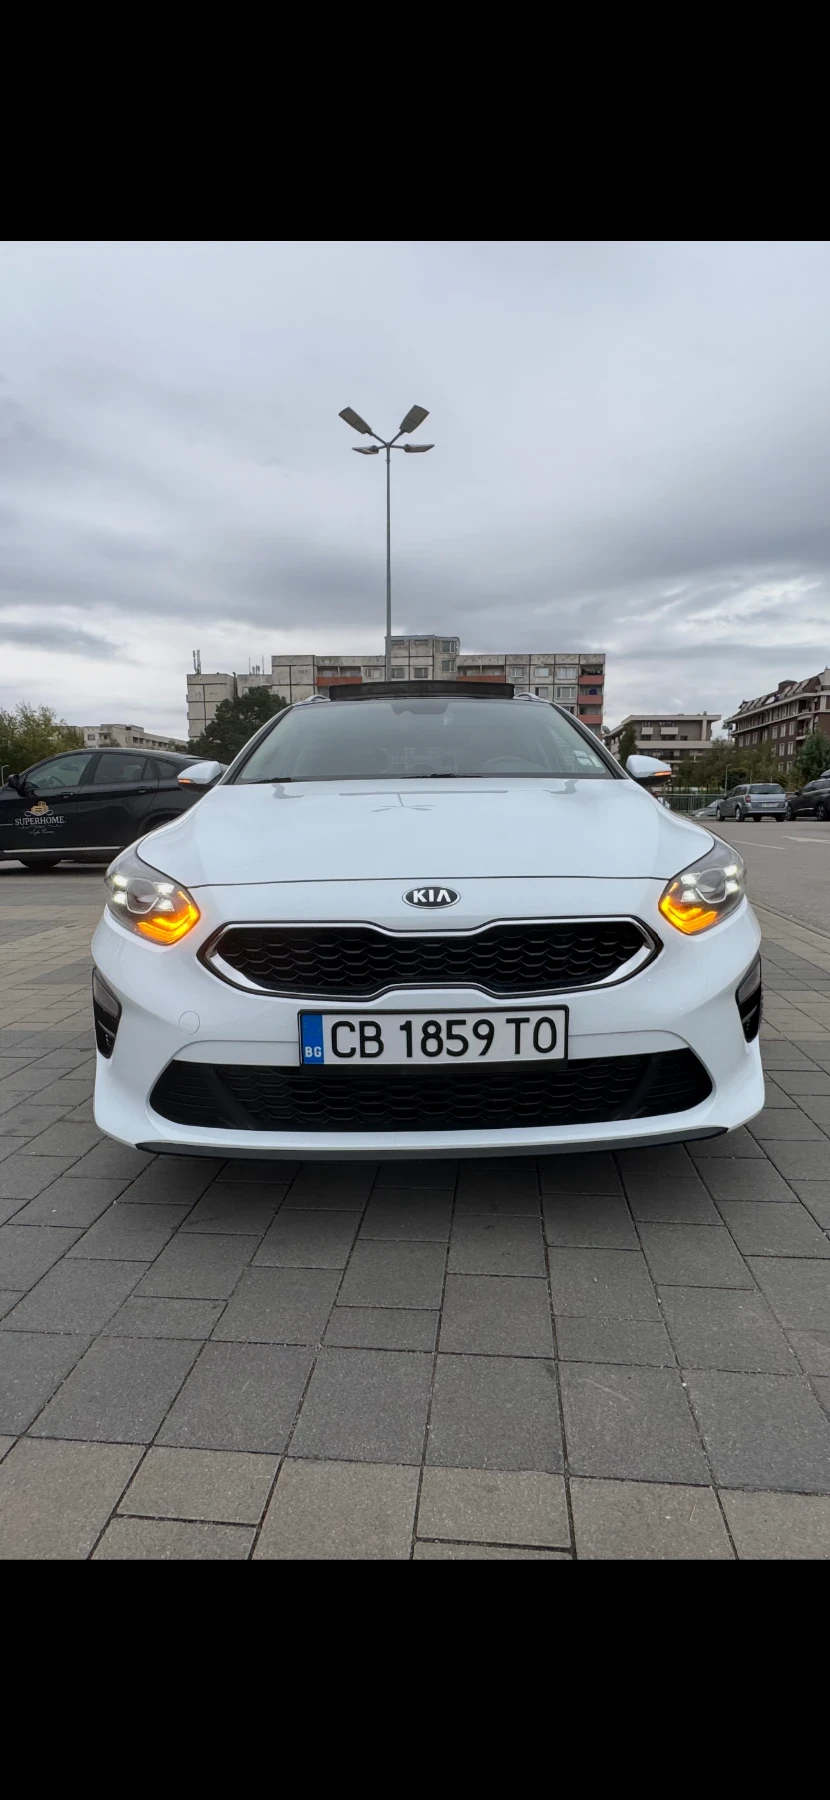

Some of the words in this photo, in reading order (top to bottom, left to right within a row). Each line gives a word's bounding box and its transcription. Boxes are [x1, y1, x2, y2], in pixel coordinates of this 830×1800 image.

[413, 889, 452, 903] KIA
[331, 1020, 385, 1059] CB
[400, 1019, 495, 1058] 1859
[505, 1016, 558, 1055] TO
[305, 1046, 322, 1058] BG
